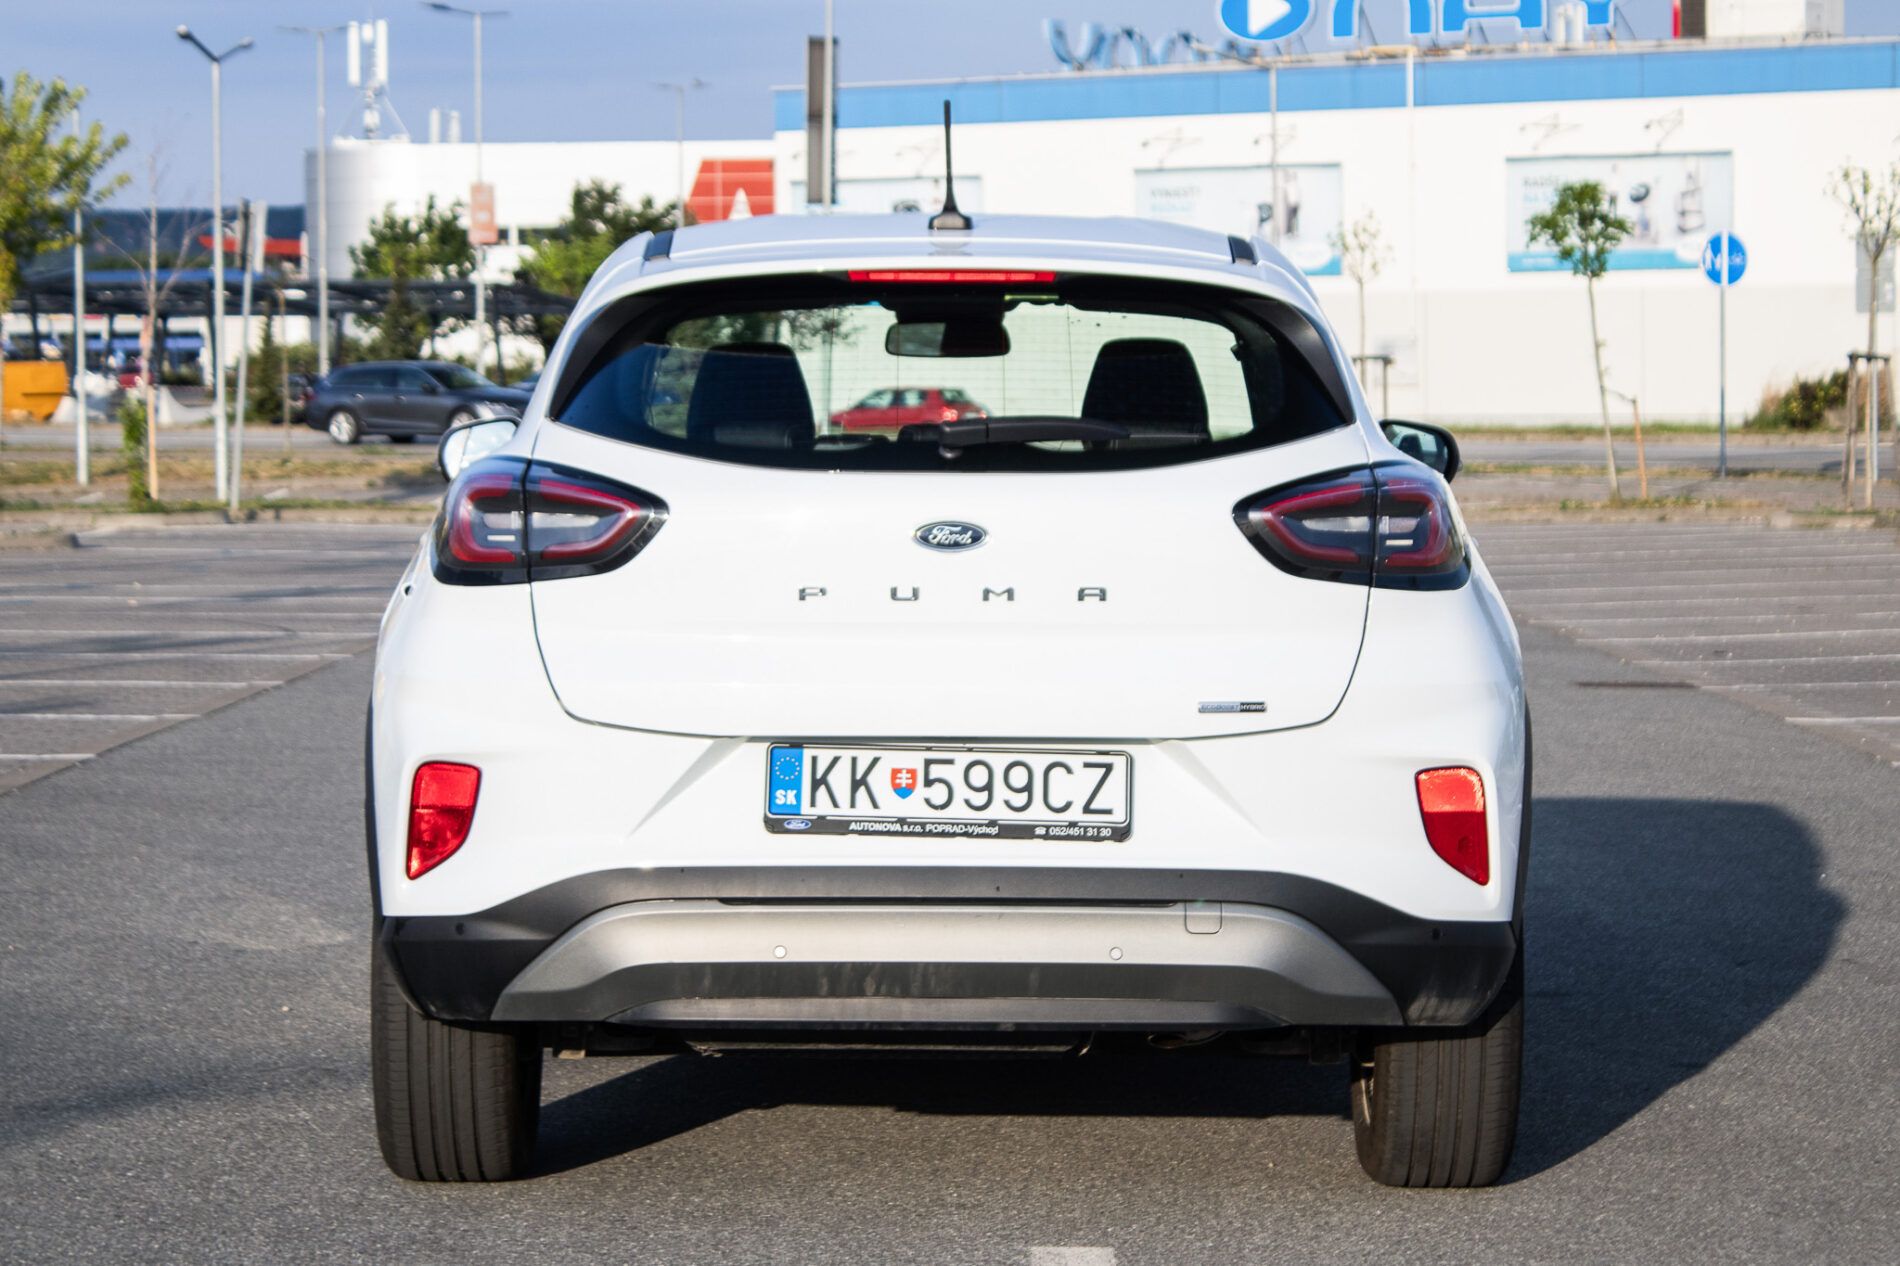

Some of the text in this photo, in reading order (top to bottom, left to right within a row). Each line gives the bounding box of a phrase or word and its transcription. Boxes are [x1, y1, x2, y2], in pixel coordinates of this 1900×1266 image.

[927, 525, 973, 545] Ford
[798, 586, 1107, 601] PUMA
[810, 755, 1115, 815] KK 599CZ
[775, 790, 798, 805] SK
[849, 821, 902, 832] AUTONOVA
[1086, 828, 1098, 836] 31
[1100, 828, 1112, 837] 30
